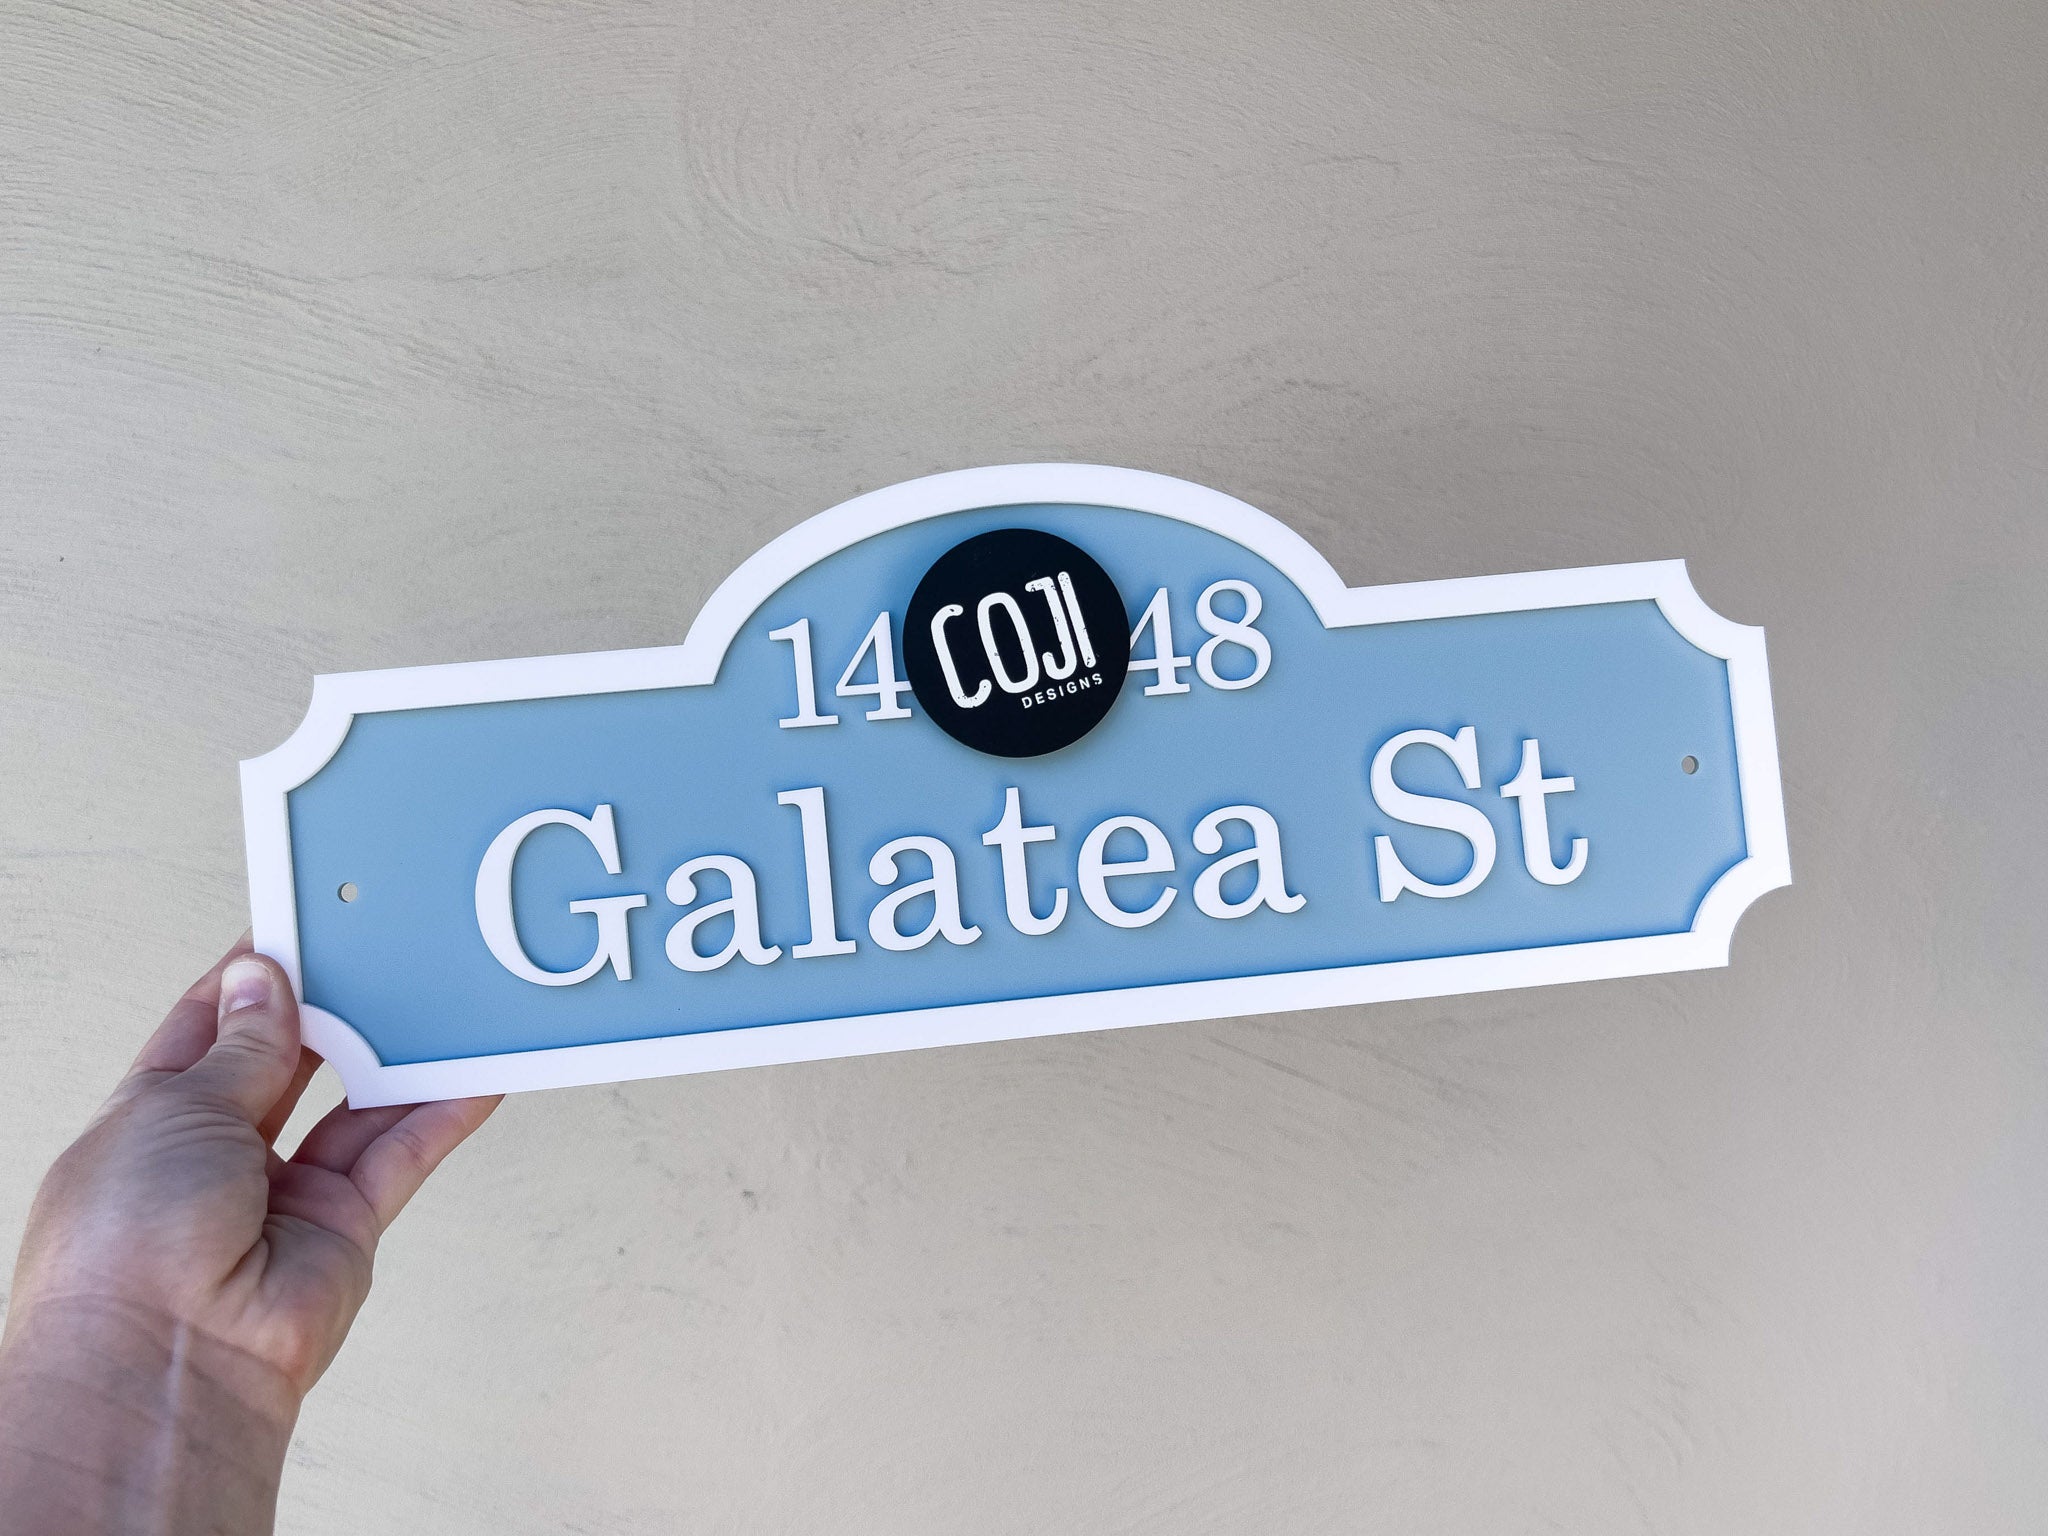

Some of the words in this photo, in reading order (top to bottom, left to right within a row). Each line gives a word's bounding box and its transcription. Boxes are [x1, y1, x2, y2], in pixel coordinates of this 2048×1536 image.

[931, 571, 1097, 708] COJI
[1021, 672, 1104, 709] DESIGNS
[474, 786, 1308, 988] Galatea
[1370, 725, 1590, 904] St
